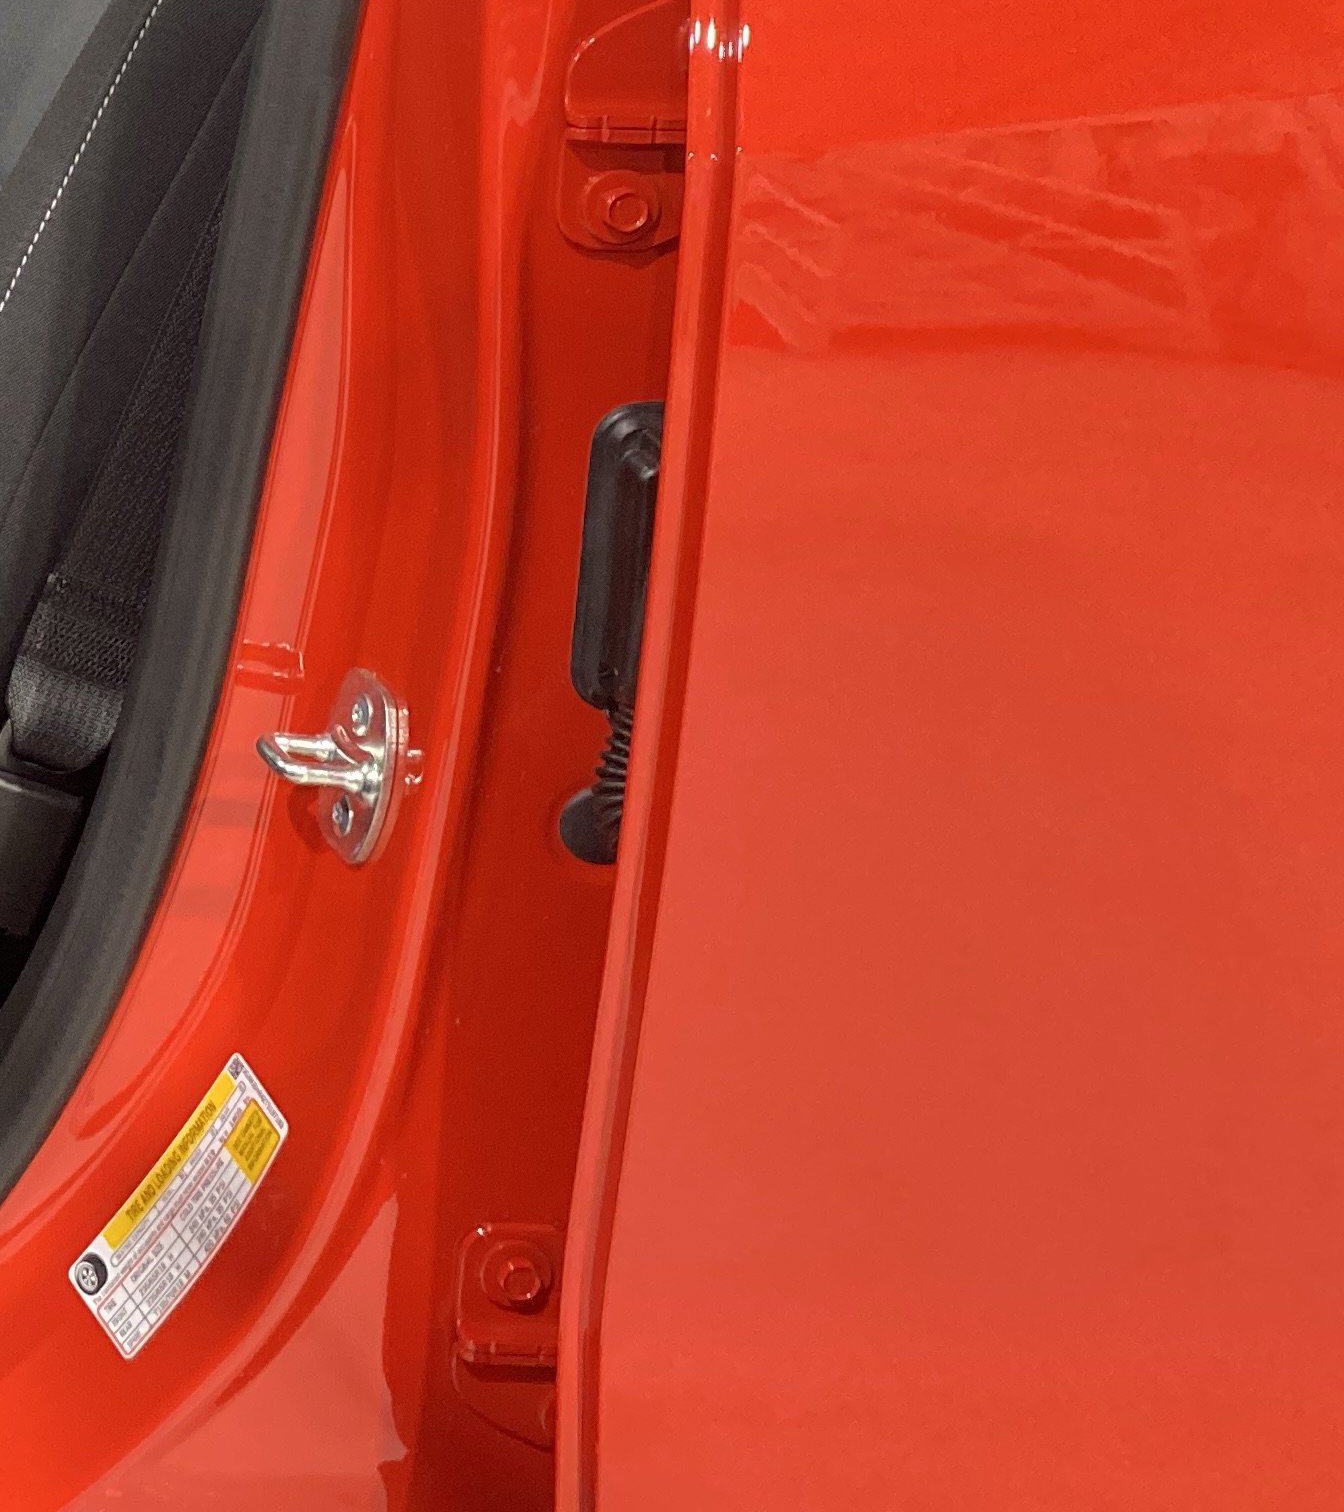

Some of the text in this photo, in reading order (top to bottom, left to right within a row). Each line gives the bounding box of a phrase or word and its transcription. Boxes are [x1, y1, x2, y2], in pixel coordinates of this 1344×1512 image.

[124, 1196, 144, 1224] TIRE
[138, 1180, 157, 1206] AND
[150, 1148, 182, 1190] LOADING
[177, 1099, 216, 1155] INFORMATION
